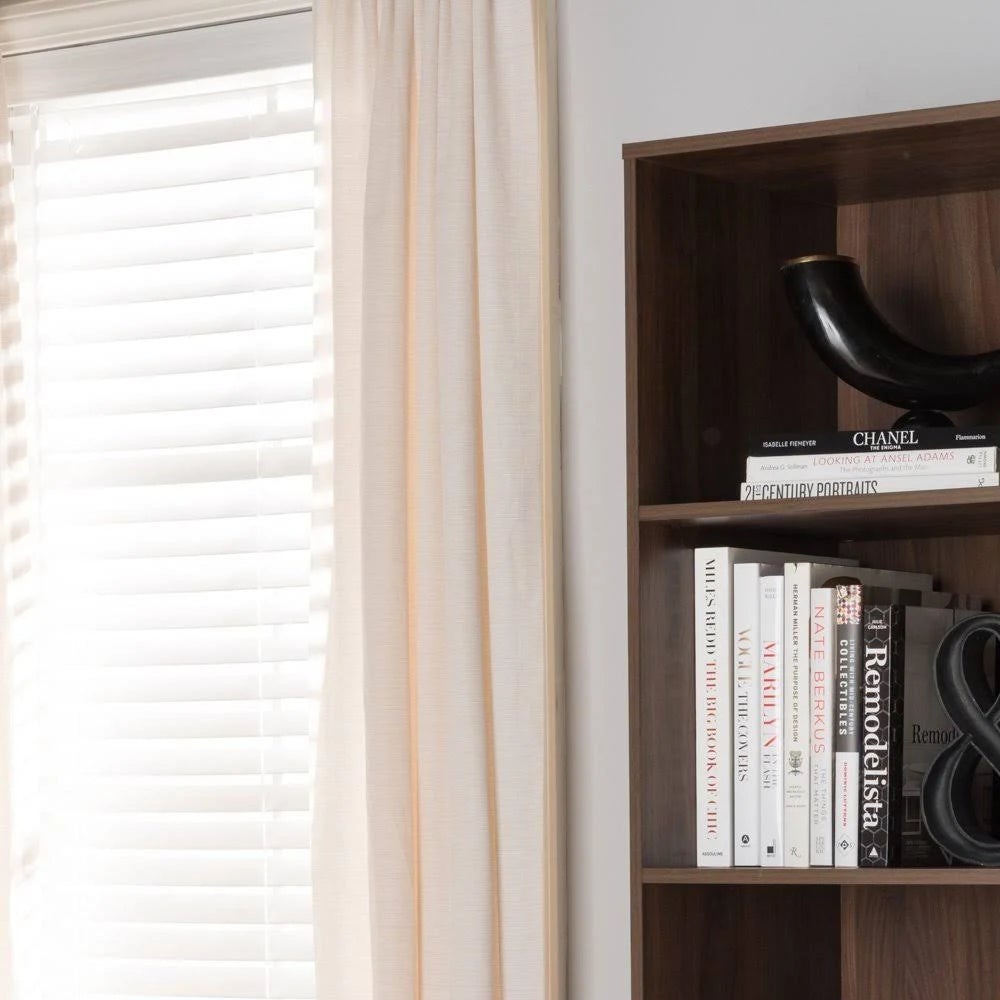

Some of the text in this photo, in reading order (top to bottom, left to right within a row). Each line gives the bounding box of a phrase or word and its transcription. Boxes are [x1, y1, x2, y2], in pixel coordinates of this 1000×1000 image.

[762, 439, 817, 448] ISABELLE FIEMEYER
[813, 451, 955, 466] LOOKING AT ANSEL ADAMS
[852, 429, 919, 447] CHANEL
[955, 433, 986, 441] Flammarion
[762, 482, 814, 499] CENTURY
[817, 480, 878, 497] PORTRAITS
[705, 558, 719, 841] MILES REDD THE BIG BOOK OF CHIC
[737, 624, 753, 783] VOGUE THE COVERS
[763, 640, 777, 748] MARILYN
[813, 606, 826, 754] NATE BERKUS
[839, 639, 848, 736] COLLECTIBLES
[863, 645, 888, 830] Remodelista
